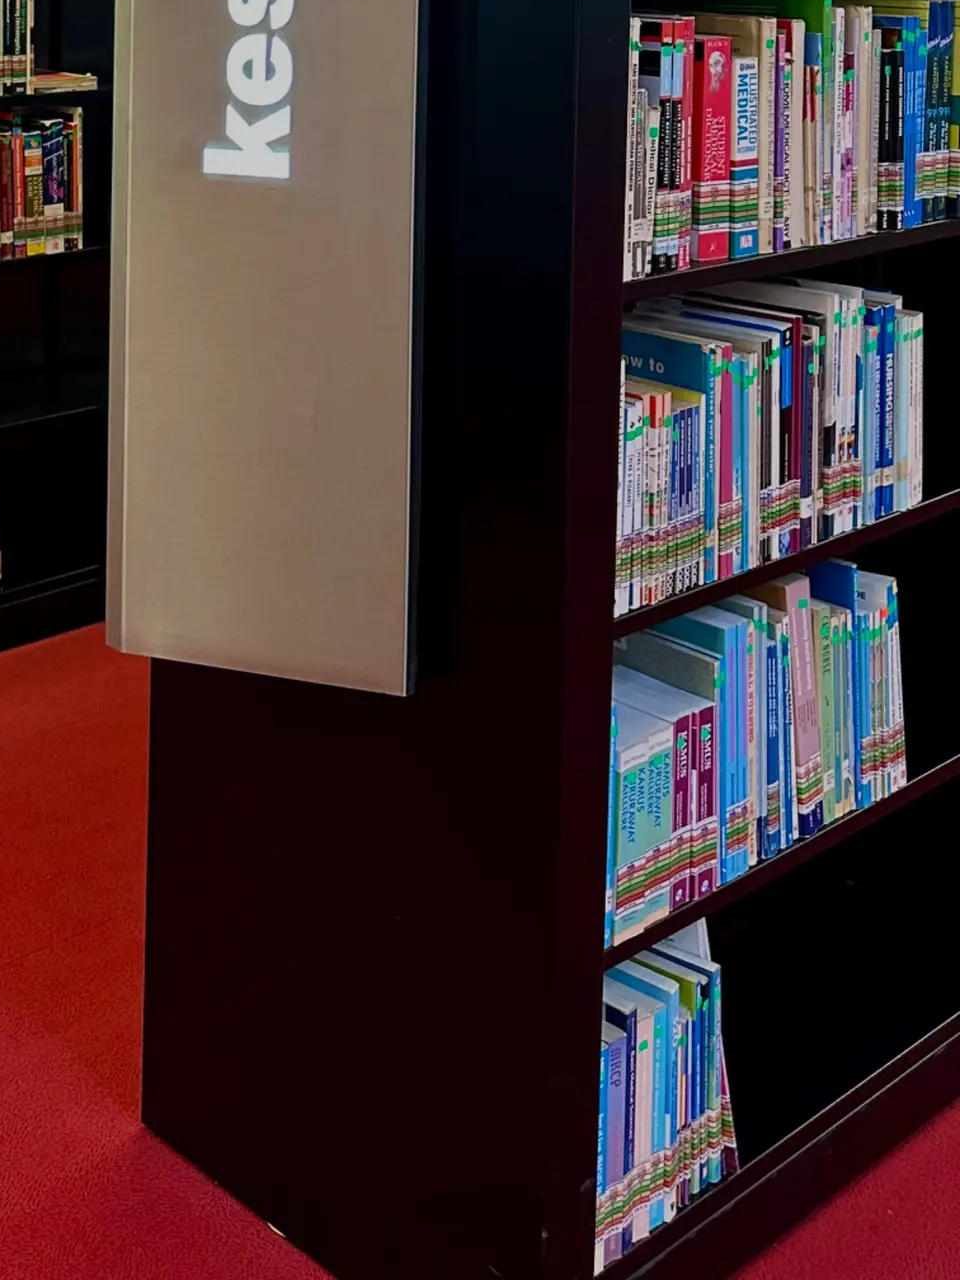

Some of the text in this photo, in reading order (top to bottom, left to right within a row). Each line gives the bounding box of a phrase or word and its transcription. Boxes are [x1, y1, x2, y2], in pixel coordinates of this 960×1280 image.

[737, 73, 748, 146] MEDICAL
[748, 72, 758, 145] ILLUSTRATED
[648, 128, 657, 173] edical
[703, 107, 712, 183] DICTIONAR
[710, 117, 718, 173] MEDICAL
[717, 115, 726, 177] STUDENT
[620, 354, 665, 375] ow to
[885, 352, 894, 411] NURSING
[820, 615, 831, 676] CP NURSE
[636, 767, 645, 813] KAMUS
[662, 752, 670, 797] KAMUS
